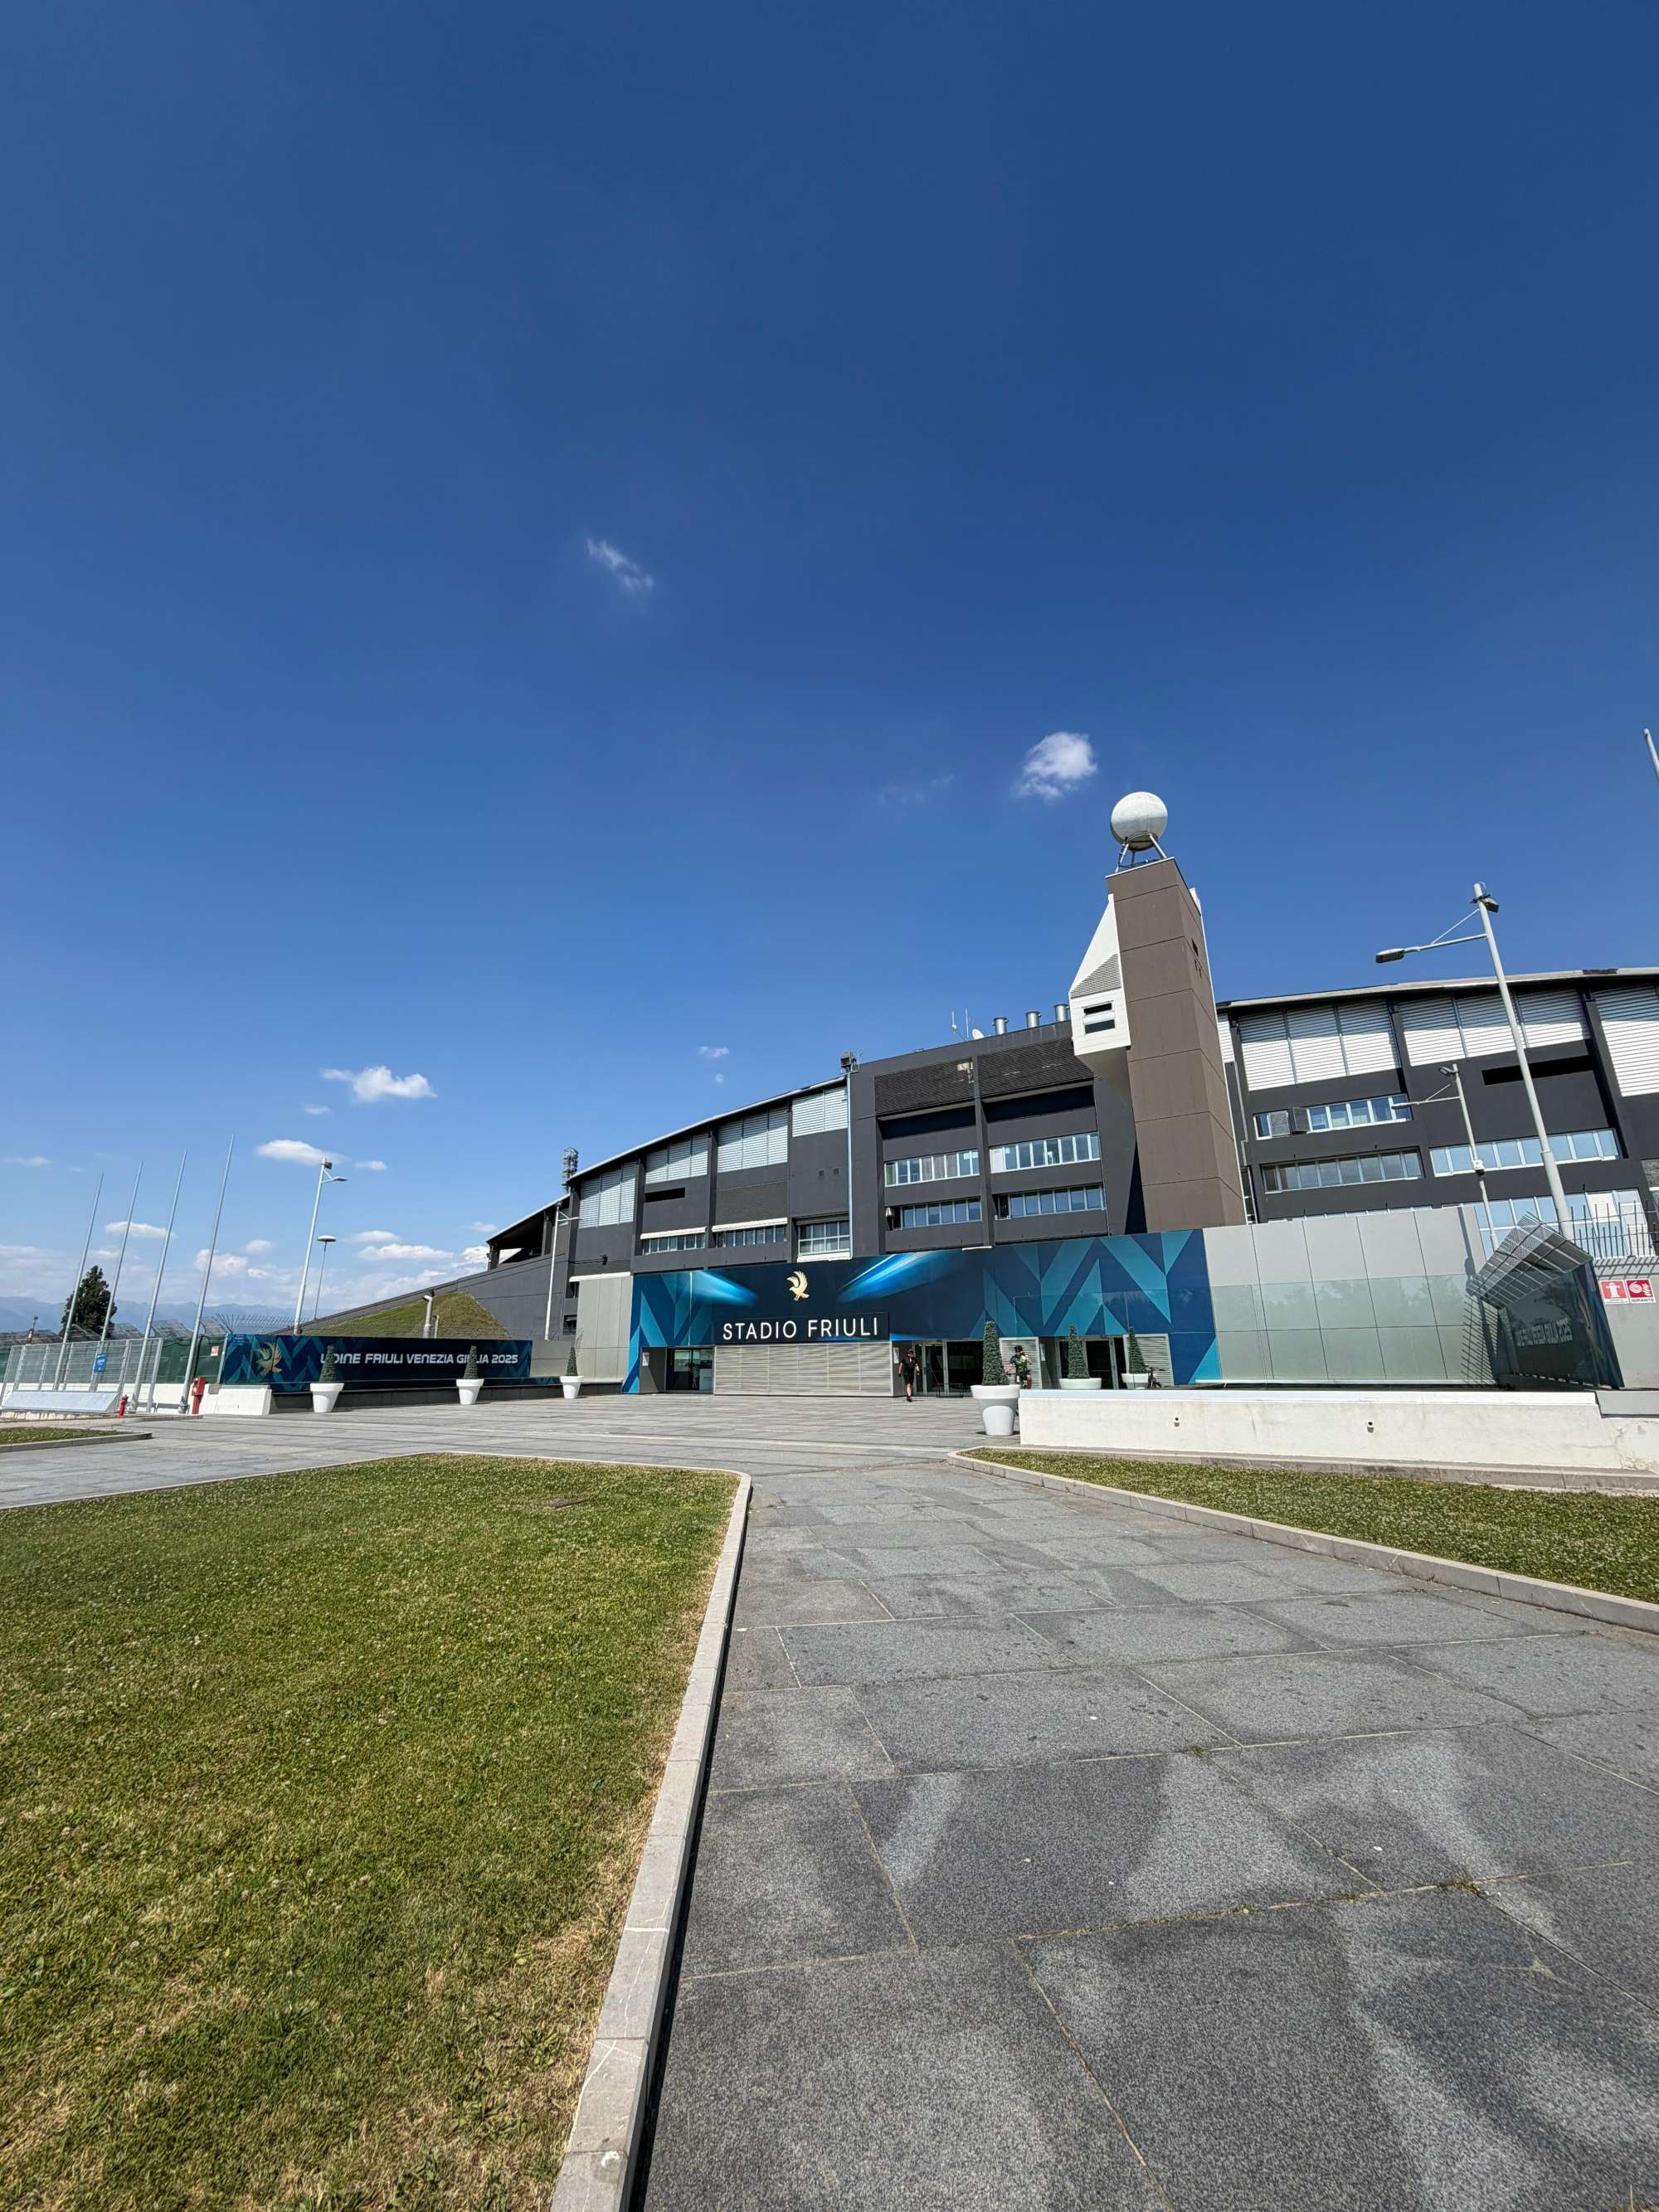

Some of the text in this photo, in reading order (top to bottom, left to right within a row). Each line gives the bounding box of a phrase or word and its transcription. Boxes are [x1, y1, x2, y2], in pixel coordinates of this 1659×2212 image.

[722, 1317, 878, 1339] STADIO FRIULI
[365, 1353, 404, 1364] FRIULI
[406, 1354, 455, 1364] VENEZIA
[456, 1354, 489, 1364] GIIA
[491, 1354, 518, 1364] 2025
